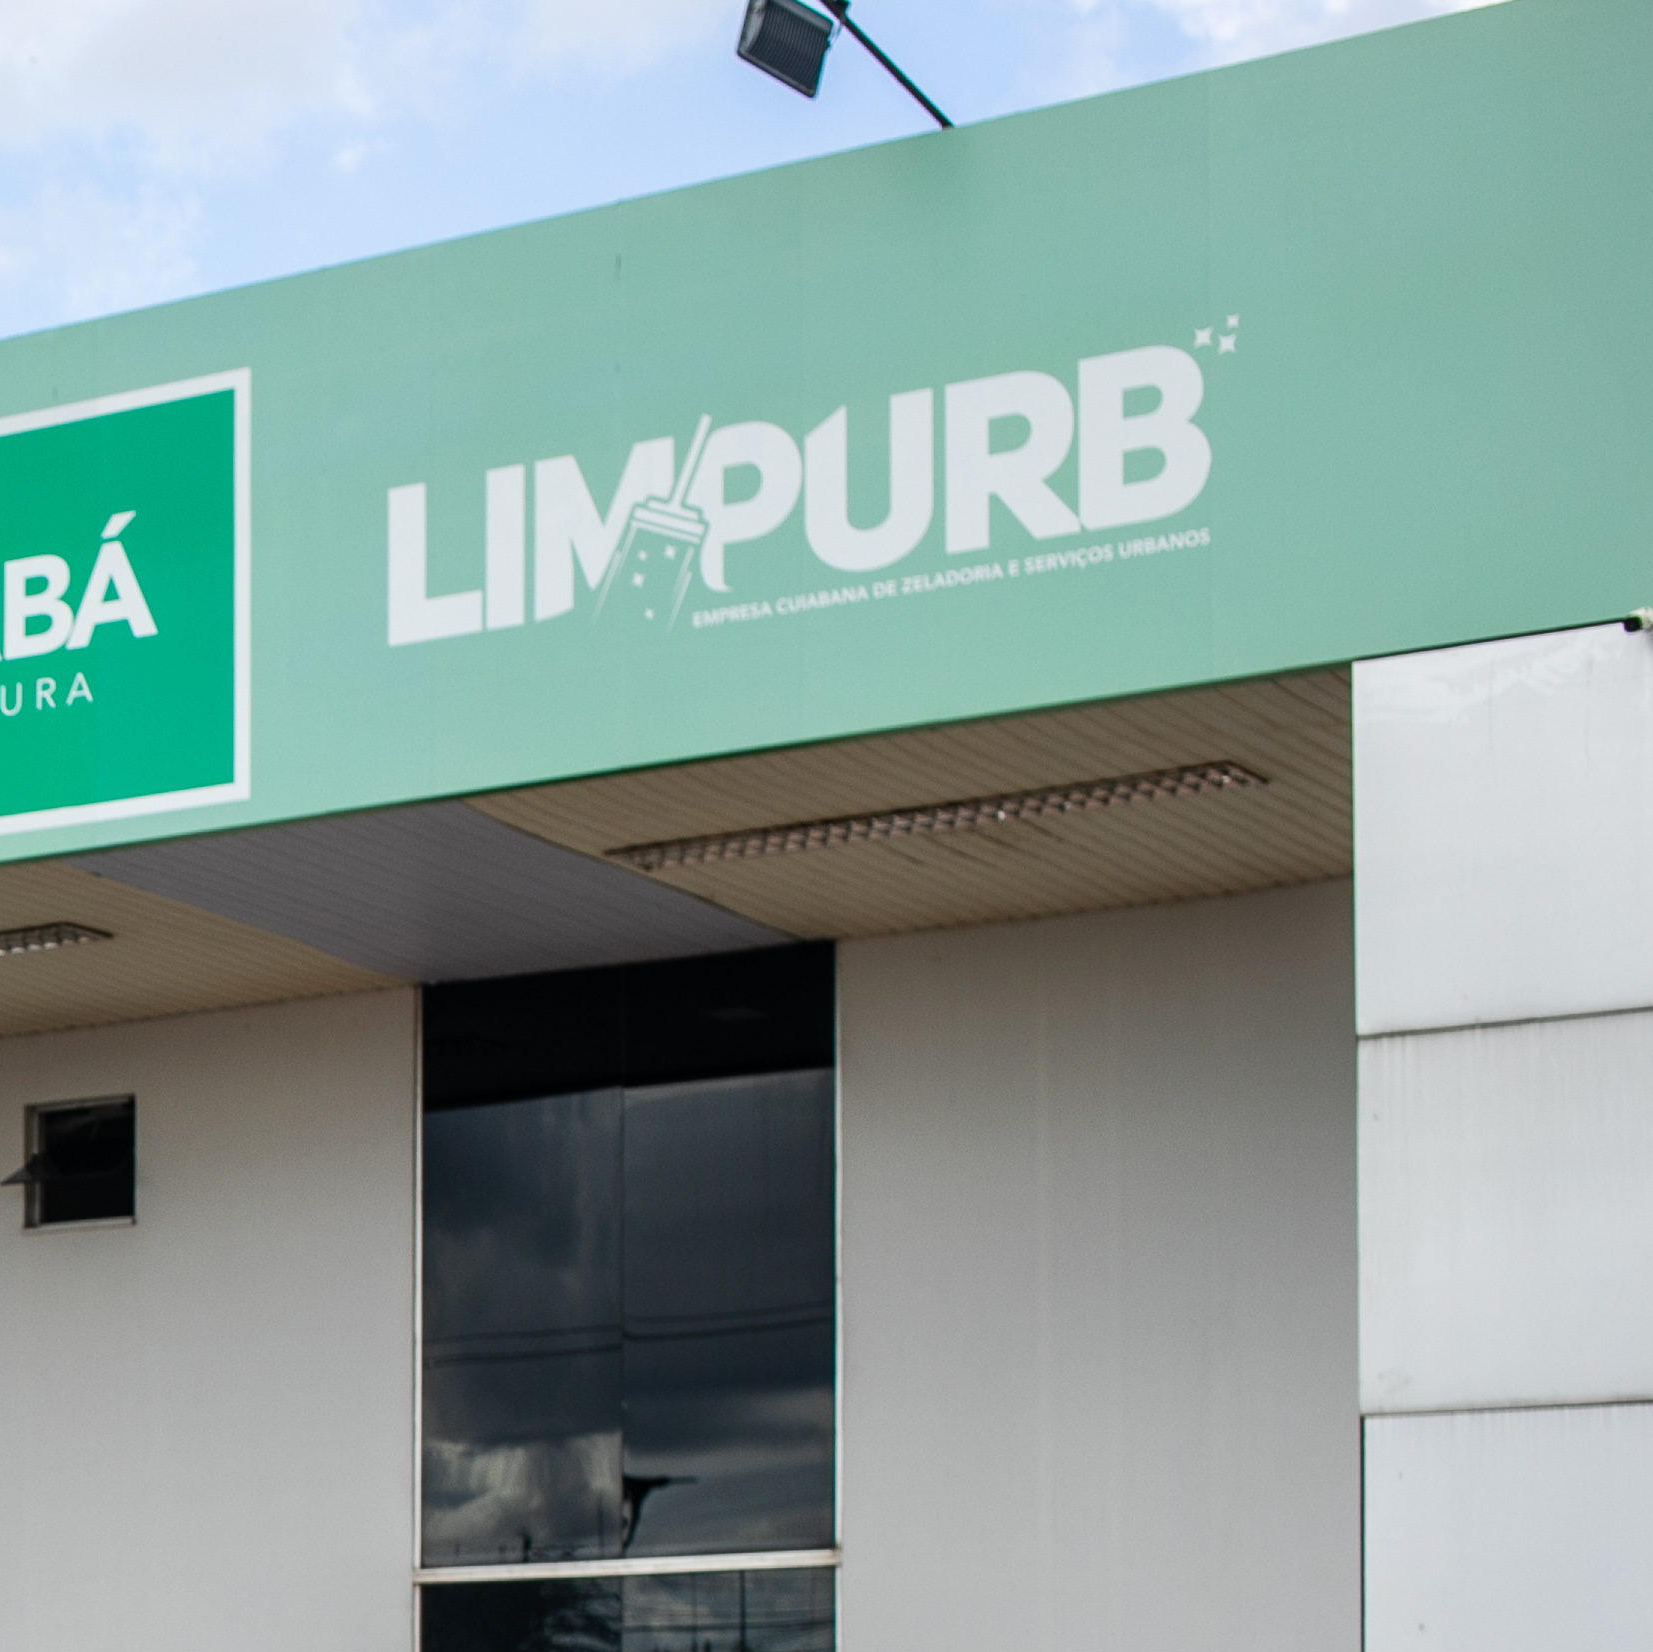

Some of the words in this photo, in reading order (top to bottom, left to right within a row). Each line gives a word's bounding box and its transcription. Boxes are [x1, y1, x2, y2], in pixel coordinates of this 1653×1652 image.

[387, 345, 1213, 648] LIMPURB
[691, 601, 773, 628] EMPRESA
[776, 585, 869, 615] CUIABANA
[873, 577, 898, 598] DE
[901, 560, 1004, 595] ZELADORIA
[1008, 559, 1020, 577] E
[1024, 543, 1115, 574] SERVIÇOS
[1118, 528, 1211, 561] URBANOS
